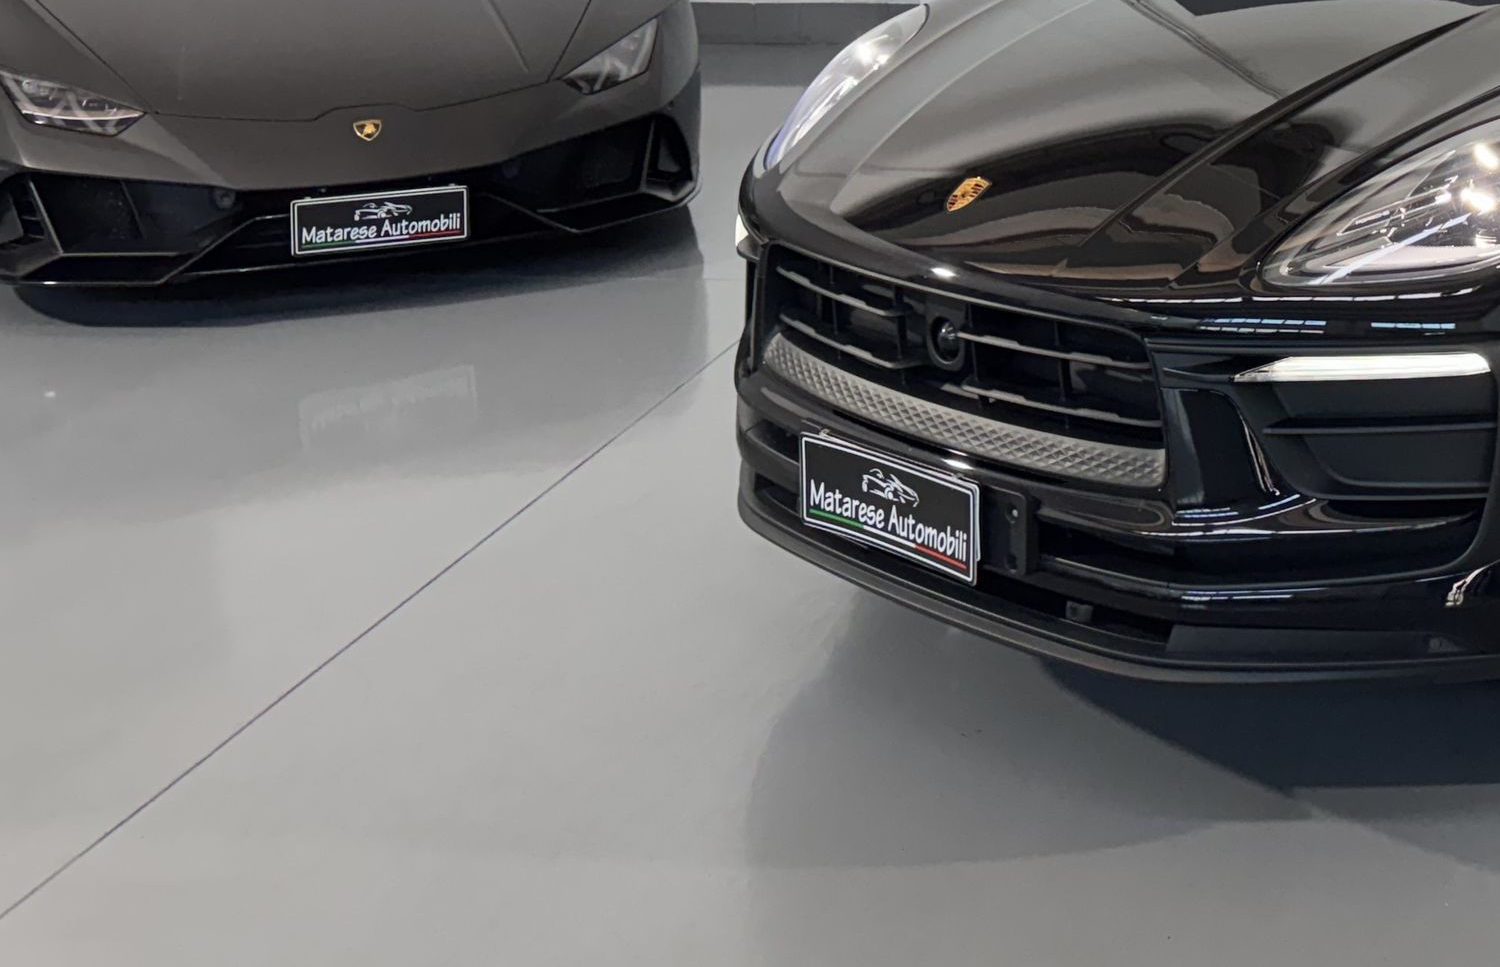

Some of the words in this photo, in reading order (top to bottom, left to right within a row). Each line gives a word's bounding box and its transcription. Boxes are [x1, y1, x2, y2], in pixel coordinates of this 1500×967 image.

[302, 224, 377, 244] Matarese
[380, 213, 461, 236] Automobili
[810, 479, 885, 529] Matarese
[888, 505, 968, 562] Automobili
